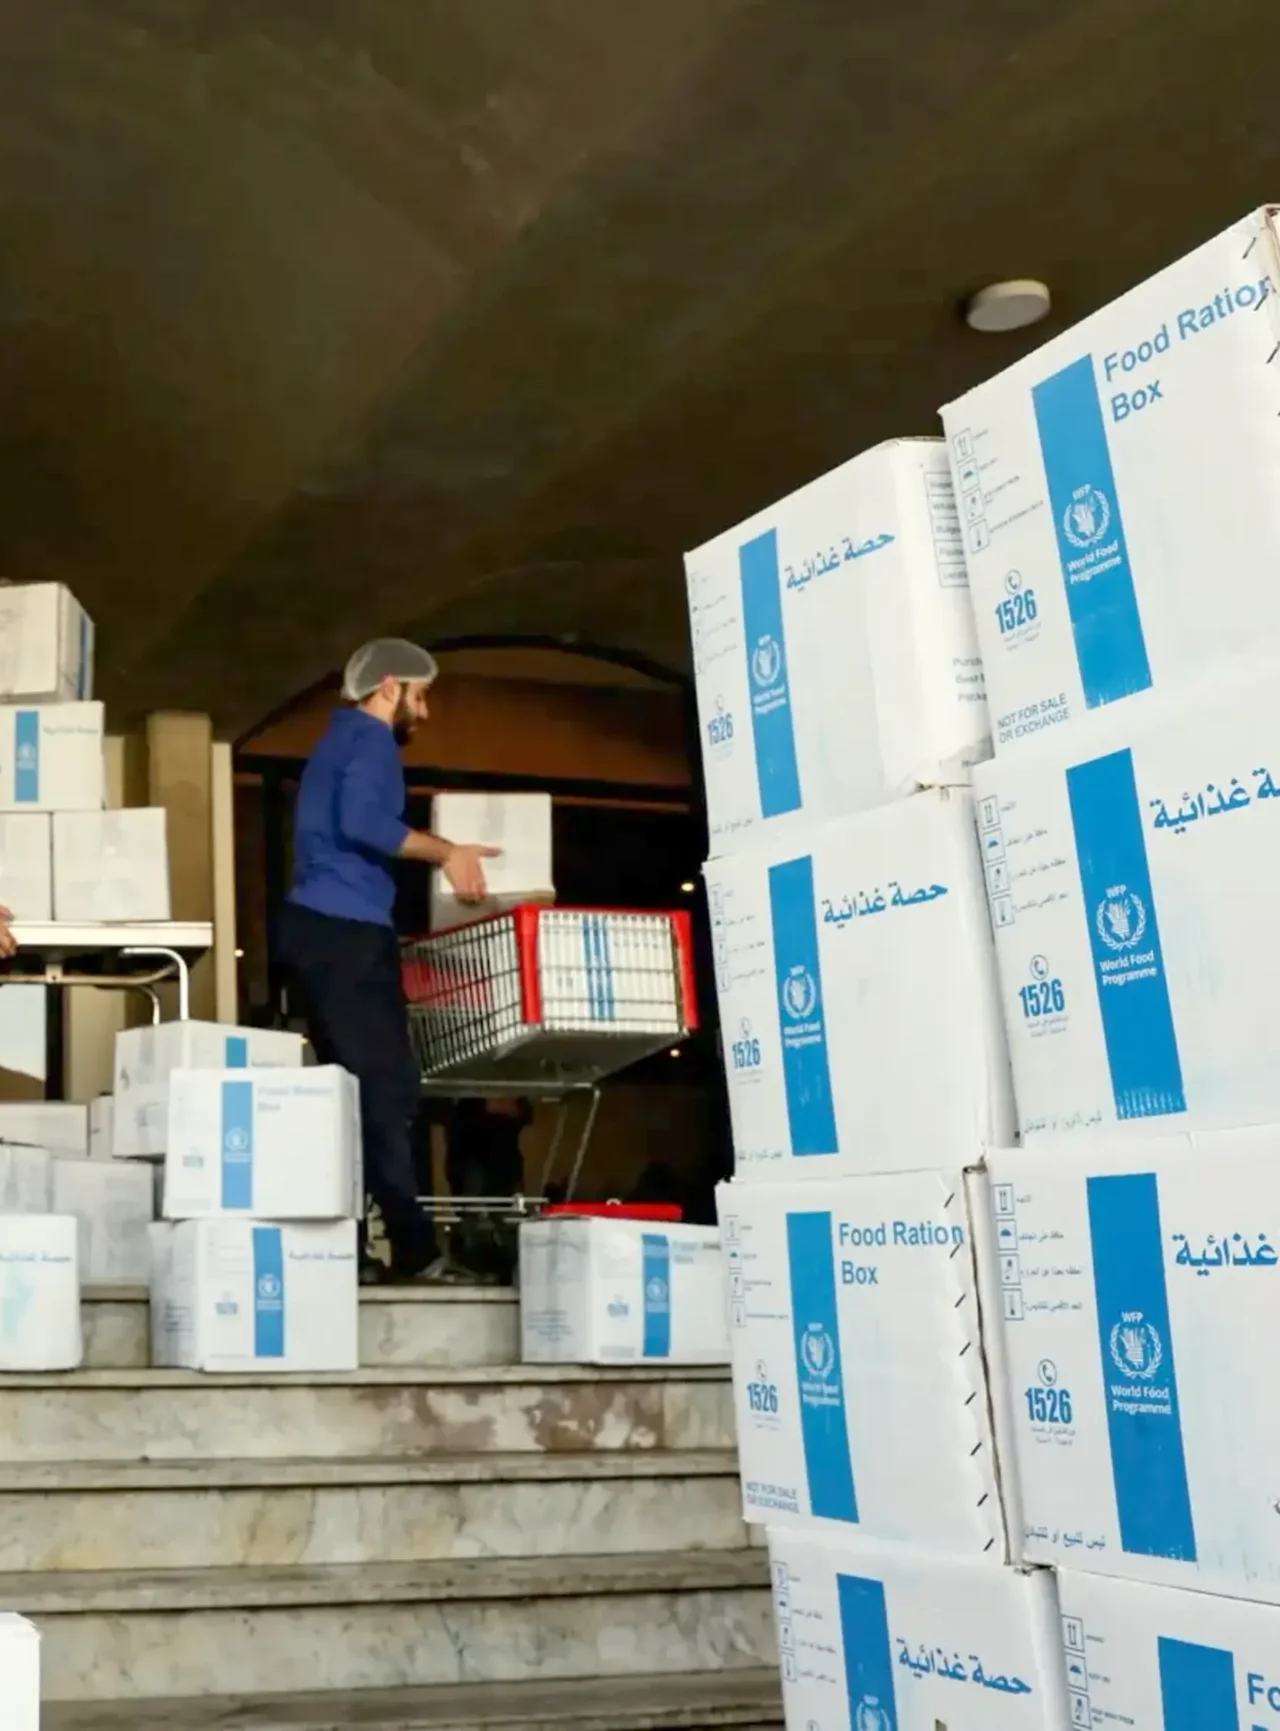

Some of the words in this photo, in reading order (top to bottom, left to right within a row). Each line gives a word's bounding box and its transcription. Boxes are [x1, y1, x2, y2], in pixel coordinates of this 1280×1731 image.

[1104, 323, 1170, 382] Food
[1111, 379, 1164, 423] Box
[842, 534, 895, 561] حصة
[1067, 552, 1095, 572] World
[1095, 540, 1119, 560] Food
[784, 546, 841, 592] غذائية
[1070, 555, 1121, 585] Programme
[995, 589, 1037, 634] 1526
[998, 711, 1018, 730] NOT
[1019, 704, 1039, 721] FOR
[1040, 692, 1067, 714] SALE
[999, 727, 1014, 744] OR
[1015, 707, 1070, 739] EXCHANGE
[1149, 777, 1251, 835] غذائية
[822, 888, 887, 929] غذائية
[888, 882, 948, 907] حصة
[1100, 954, 1130, 972] World
[1131, 950, 1155, 968] Food
[1102, 966, 1157, 986] Programme
[1018, 978, 1065, 1018] 1526
[732, 1038, 761, 1068] 1526
[839, 1222, 887, 1247] Food
[893, 1220, 965, 1246] Ration
[841, 1260, 879, 1285] Box
[1172, 1232, 1279, 1277] غذائية
[1121, 1310, 1143, 1323] WFP
[747, 1382, 778, 1413] 1526
[1024, 1387, 1073, 1425] 1526
[1111, 1384, 1141, 1398] World
[1144, 1386, 1170, 1400] Food
[1112, 1399, 1172, 1416] Programme
[896, 1637, 968, 1682] غذائية
[969, 1655, 1032, 1694] حصة
[1247, 1671, 1280, 1714] Fo
